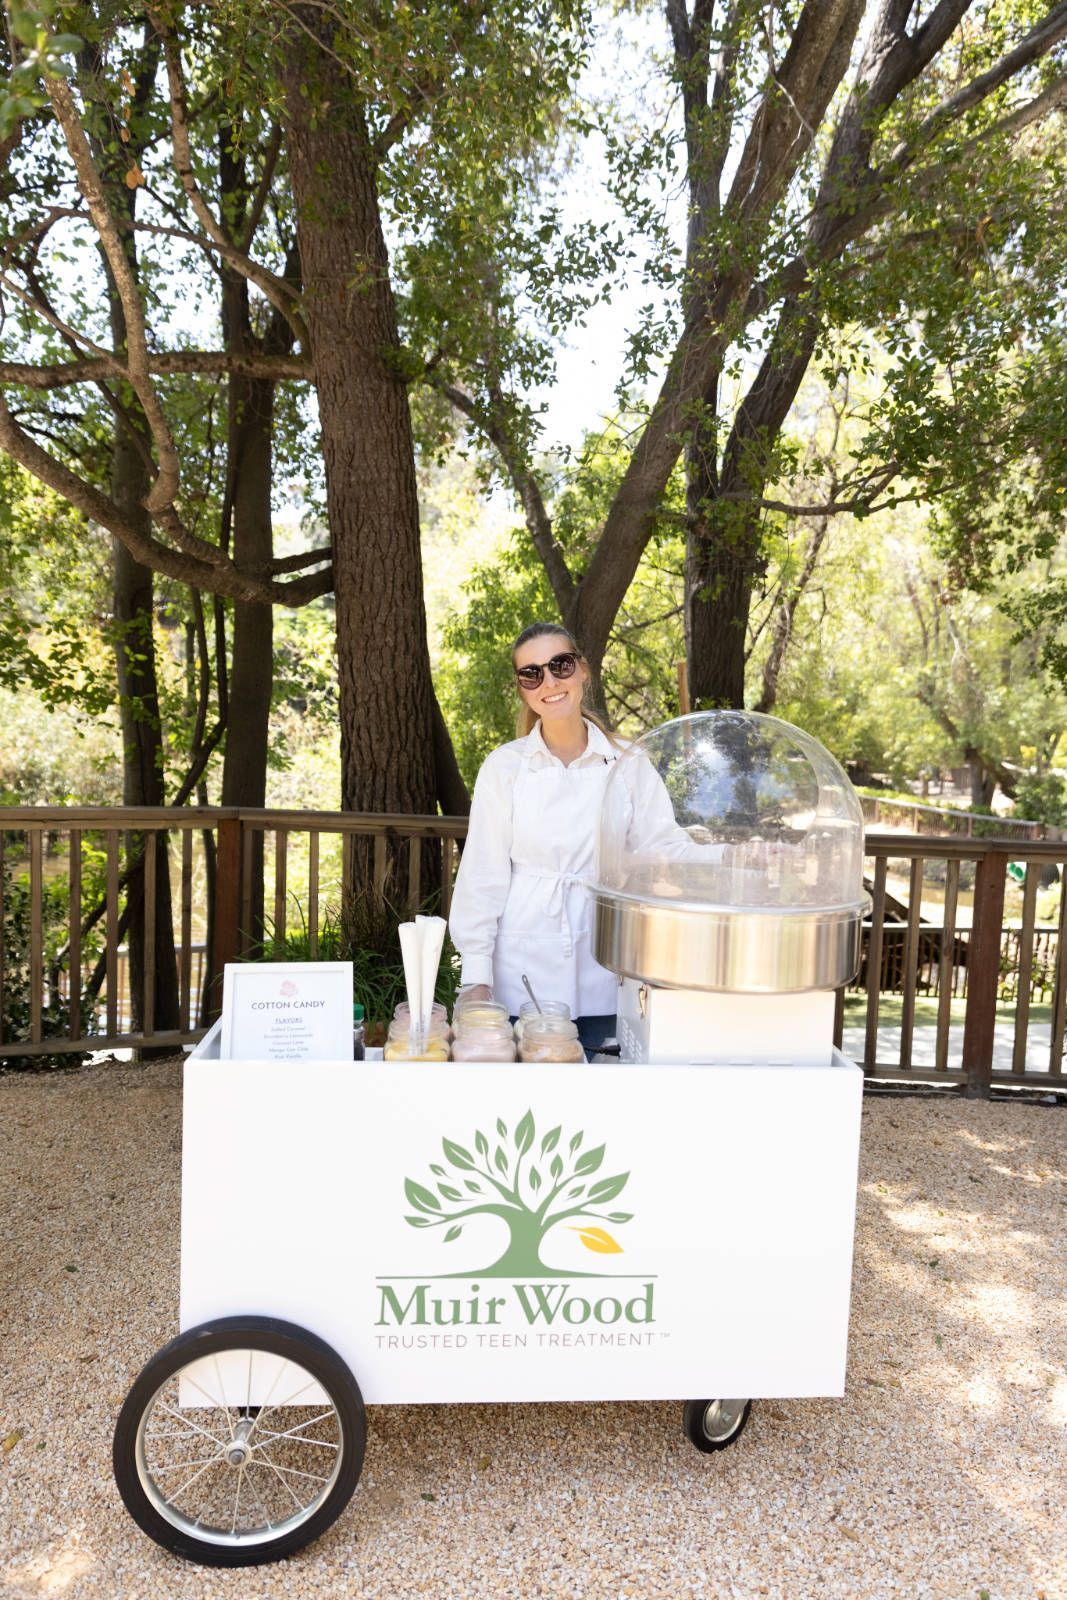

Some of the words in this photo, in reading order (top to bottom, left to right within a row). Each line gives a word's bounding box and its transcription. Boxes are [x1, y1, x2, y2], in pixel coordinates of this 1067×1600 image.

[251, 1002, 291, 1010] COTTON
[292, 1000, 326, 1009] CANDY
[374, 1284, 506, 1325] Muir
[512, 1282, 656, 1325] Wood
[375, 1334, 468, 1349] TRUSTED
[475, 1333, 528, 1348] TEEN
